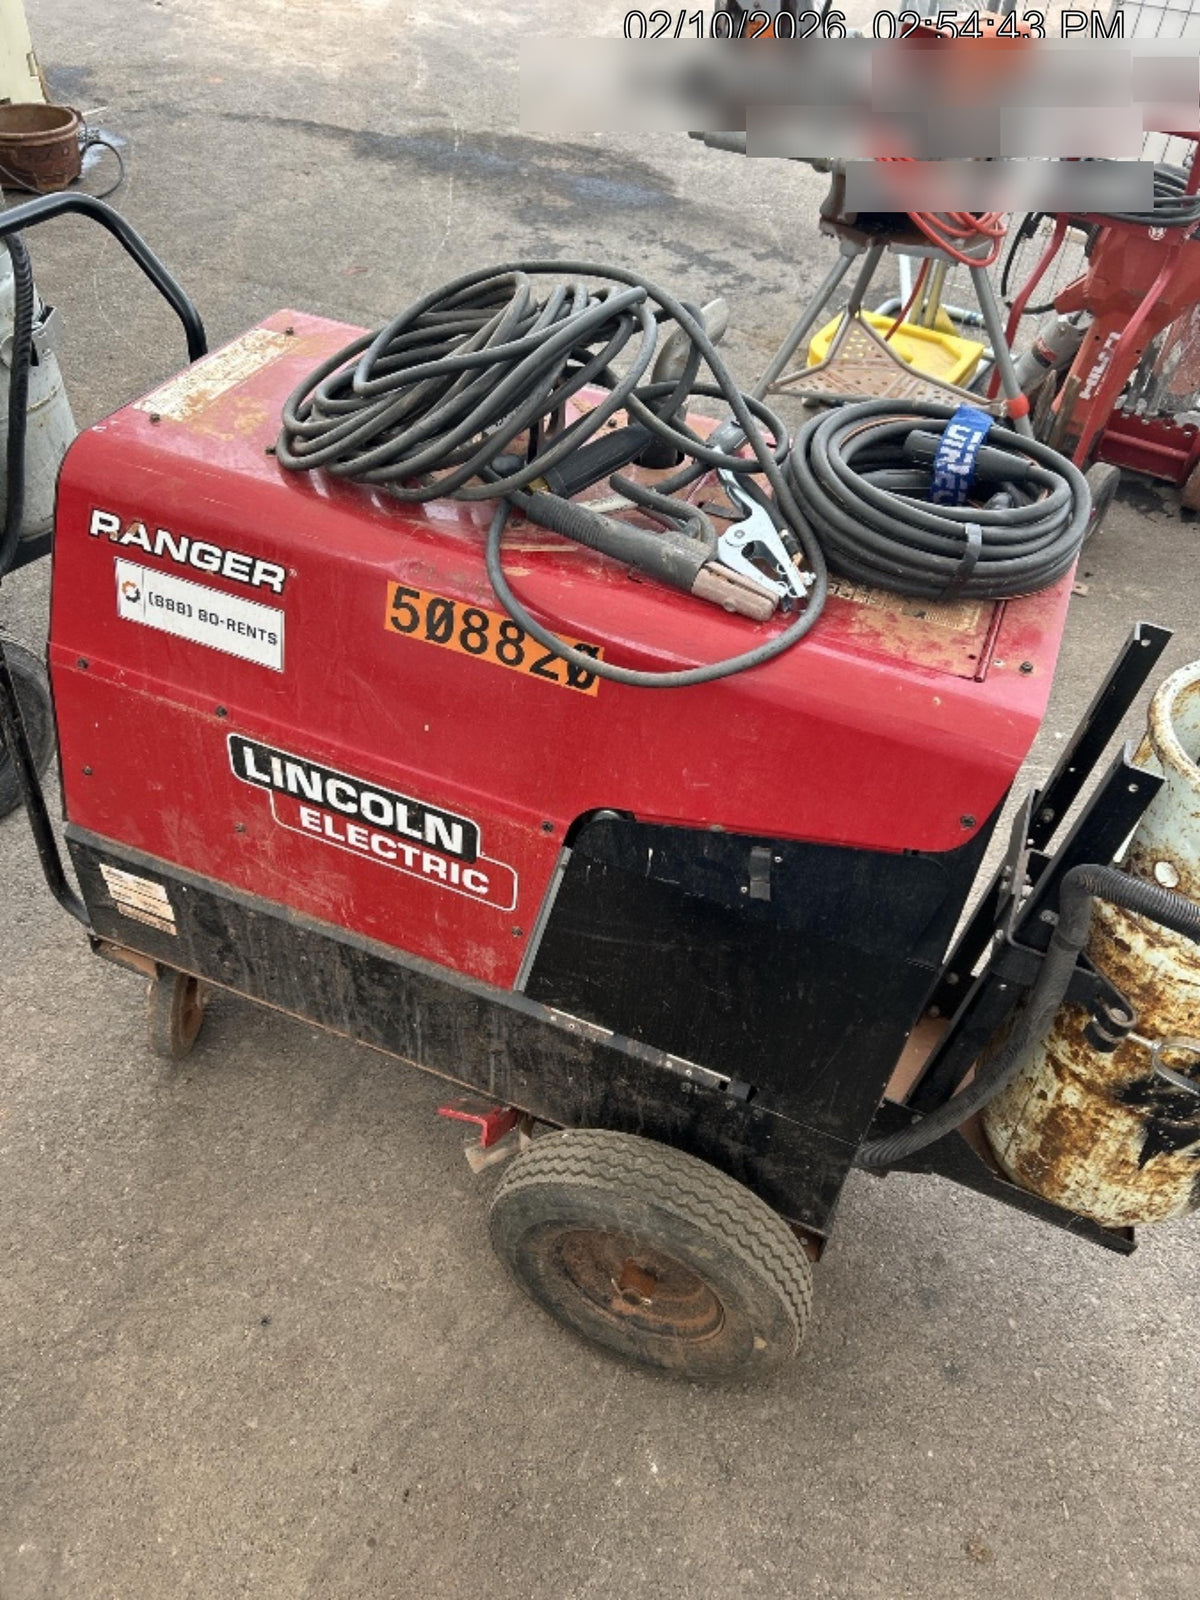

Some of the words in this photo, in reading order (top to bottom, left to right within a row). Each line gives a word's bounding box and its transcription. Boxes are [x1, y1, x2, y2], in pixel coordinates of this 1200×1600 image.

[89, 508, 288, 595] RANGER
[148, 591, 193, 618] (888)
[198, 608, 279, 646] 80-RENTS
[242, 745, 464, 855] LINCOLN
[299, 805, 491, 895] ELECTRIC
